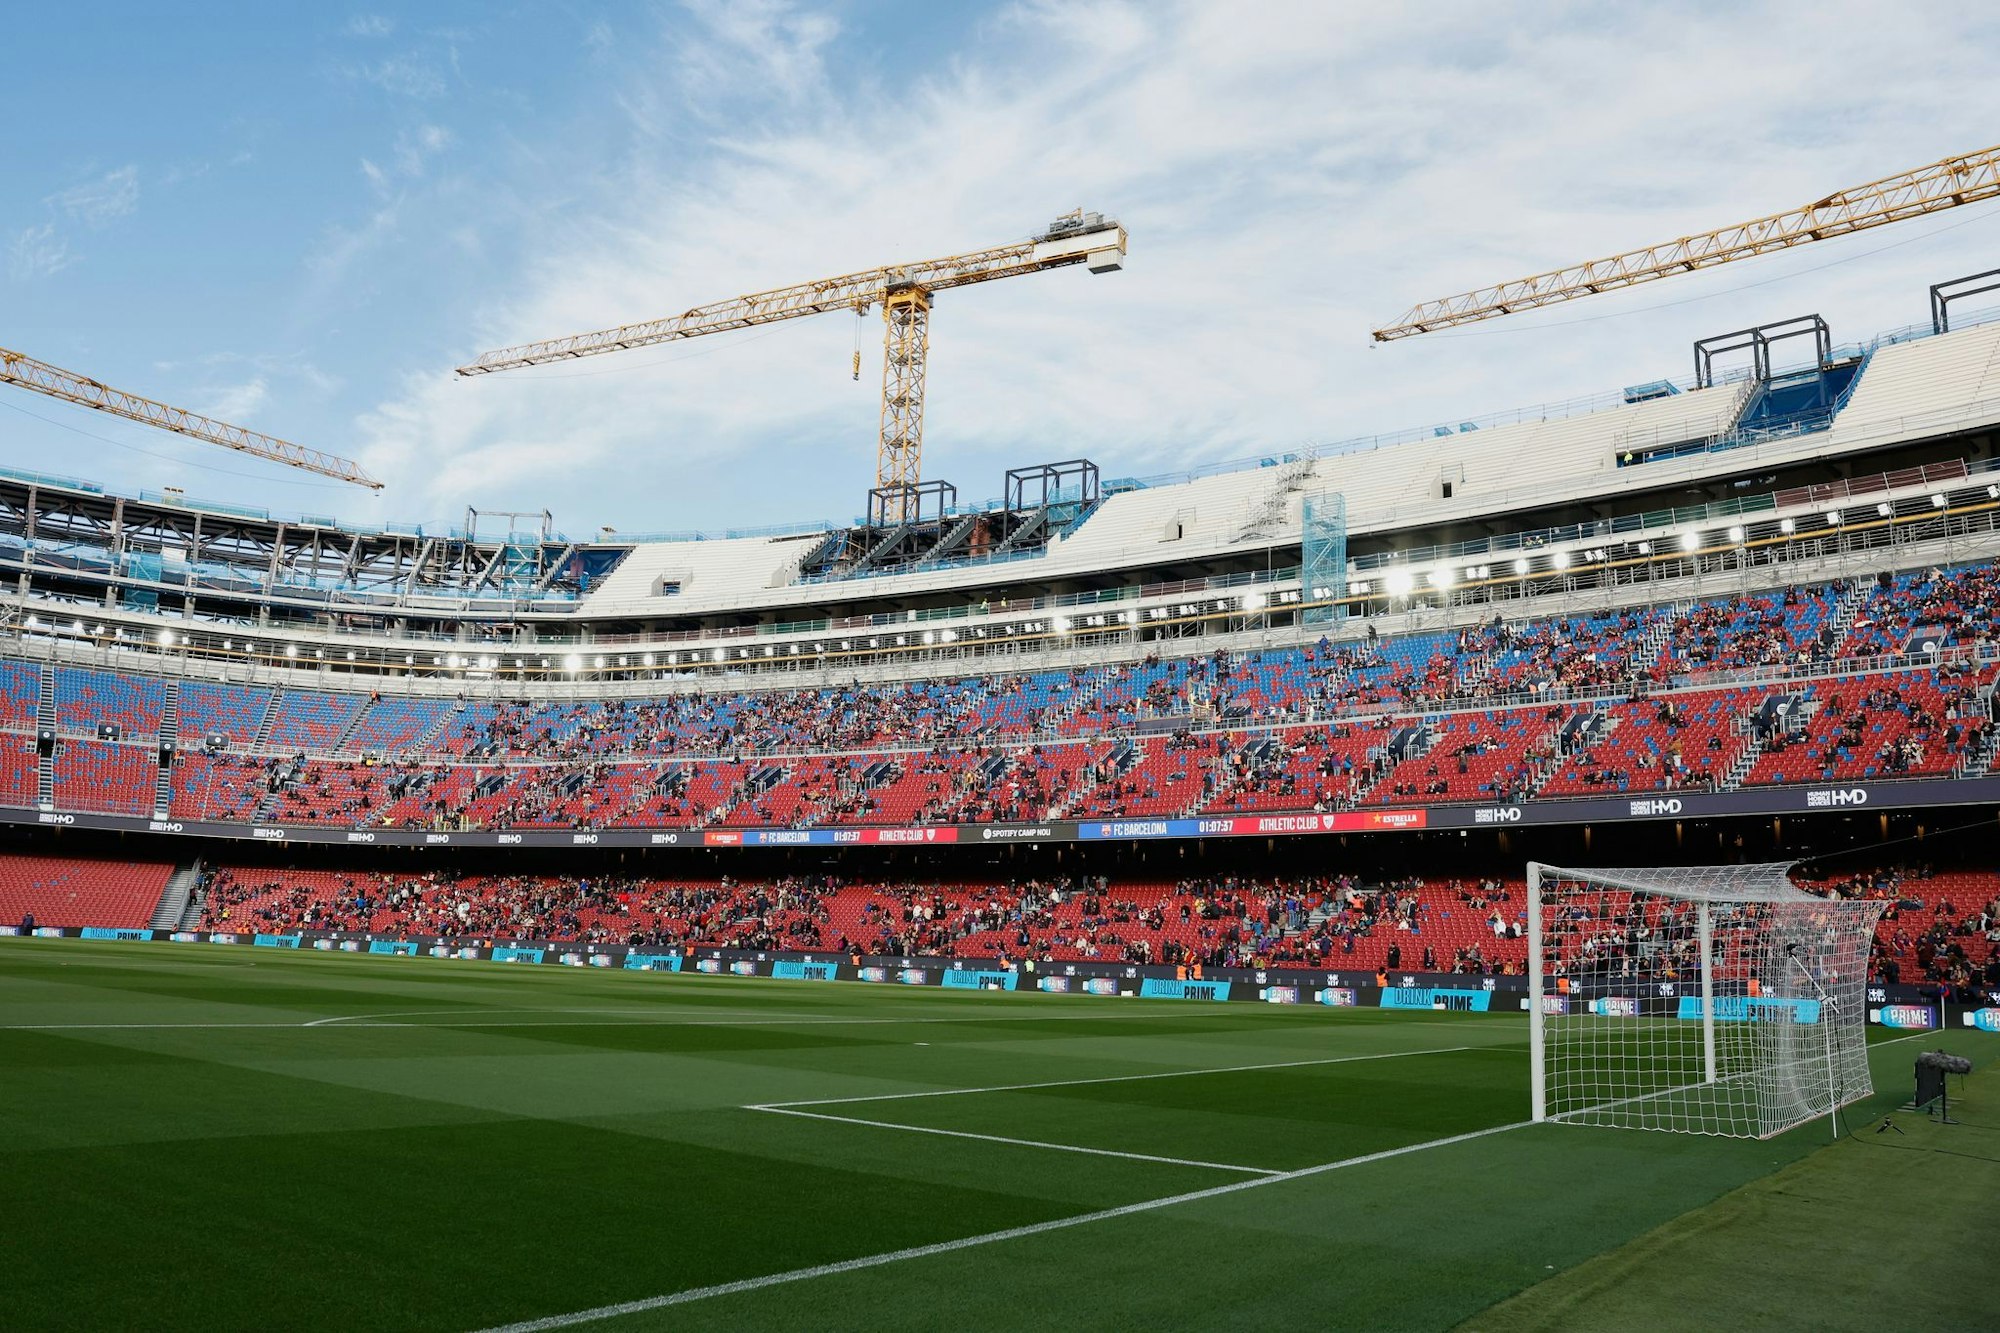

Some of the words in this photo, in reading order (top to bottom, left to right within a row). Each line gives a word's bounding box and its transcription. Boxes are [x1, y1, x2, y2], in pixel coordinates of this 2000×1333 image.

[1832, 789, 1867, 805] HMD
[1651, 799, 1682, 814] HMD
[53, 815, 74, 824] HMD
[1383, 814, 1417, 823] ESTRELLA
[1494, 807, 1521, 822] HMD
[163, 823, 183, 832] HMD
[1114, 824, 1123, 835] FC
[1124, 823, 1167, 835] BARCELONA
[1199, 820, 1233, 832] 01:07:37
[1259, 818, 1295, 831] ATHLETIC
[1297, 816, 1318, 830] CLUB
[266, 829, 284, 838] HMD
[359, 833, 375, 842] HMD
[584, 834, 598, 844] HMD
[661, 834, 677, 844] HMD
[769, 833, 776, 842] FC
[776, 832, 810, 842] BARCELONA
[834, 832, 860, 841] 01:07:37
[879, 831, 906, 841] ATHLETIC
[907, 830, 924, 841] CLUB
[992, 829, 1018, 837] SPOTIFY
[1018, 829, 1036, 837] CAMP
[117, 932, 142, 940] PRIME
[653, 960, 673, 971] PRIME
[804, 967, 827, 980] PRIME
[866, 969, 883, 981] PRIME
[906, 970, 923, 983] PRIME
[952, 970, 977, 984] DRINK
[1047, 979, 1066, 990] PRIME
[1094, 980, 1113, 992] PRIME
[1152, 980, 1182, 995] DRINK
[1184, 986, 1216, 1000] PRIME
[1272, 990, 1295, 1002] PRIME
[1394, 988, 1432, 1006] DRINK
[1542, 998, 1563, 1011] RIME
[1605, 1000, 1634, 1014] PRIME
[1890, 1009, 1928, 1025] PRIME
